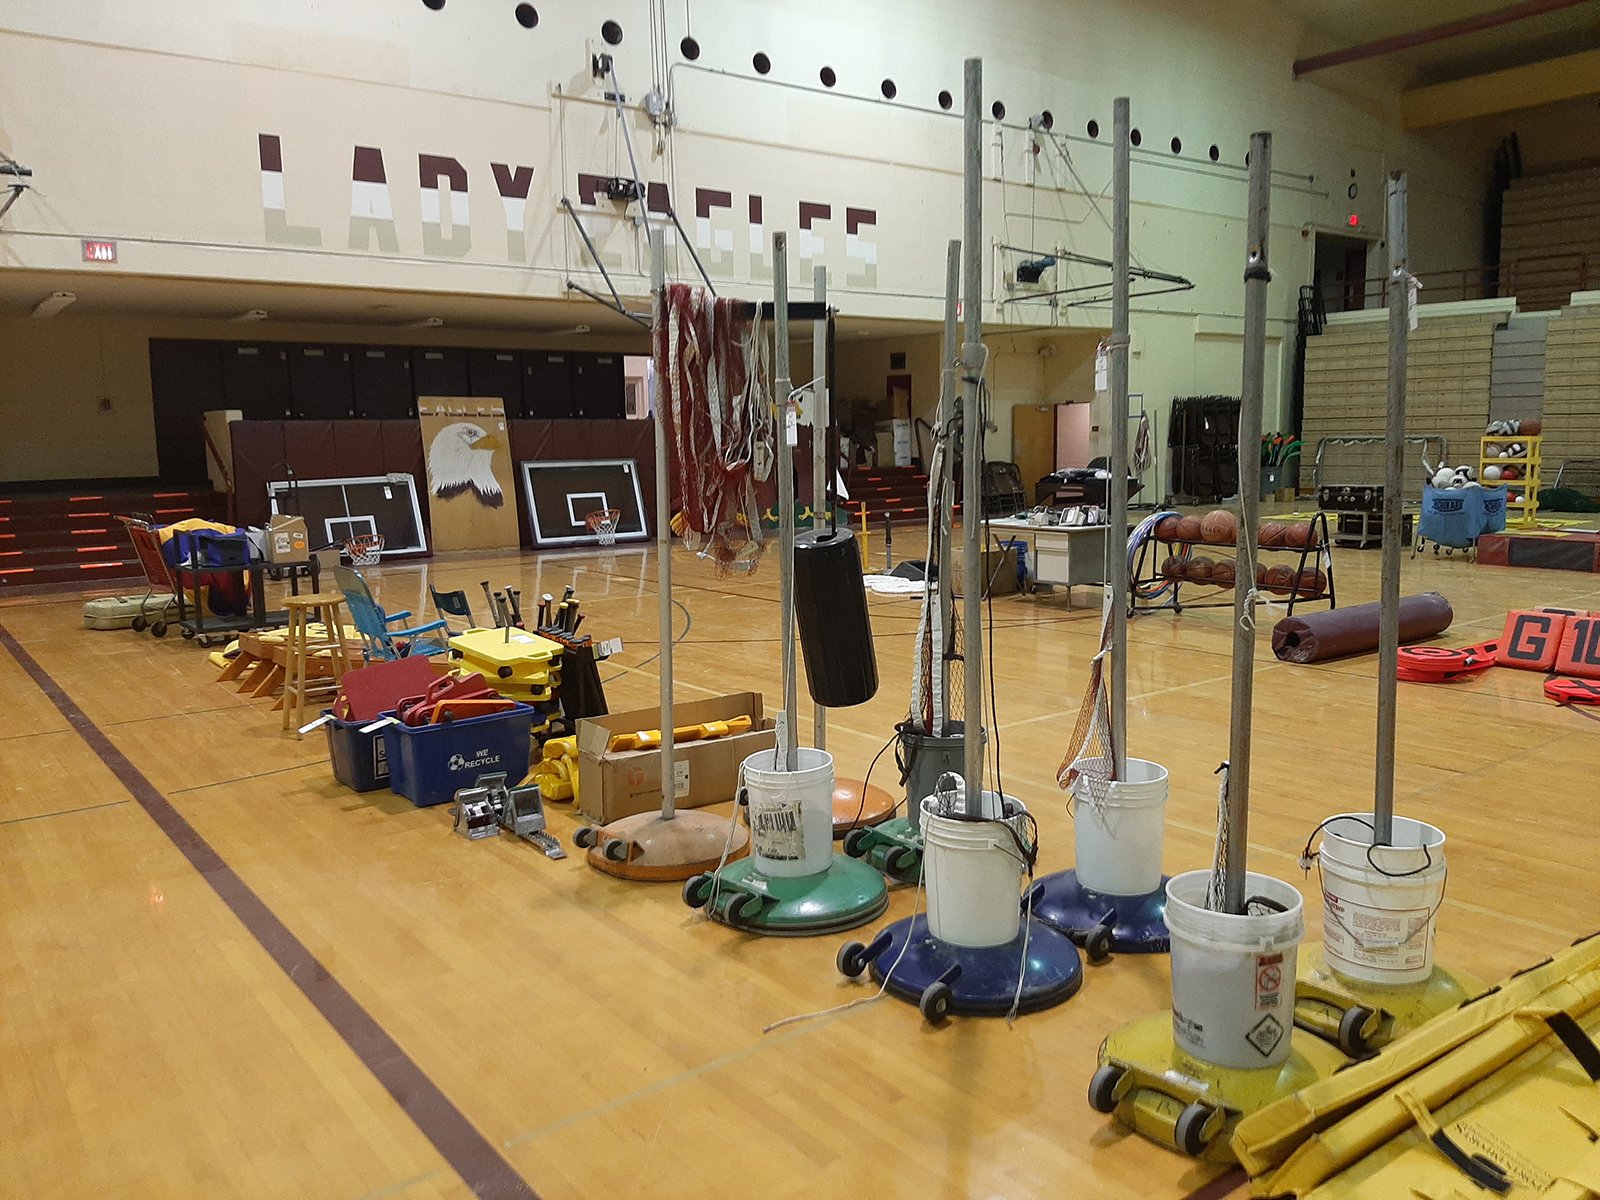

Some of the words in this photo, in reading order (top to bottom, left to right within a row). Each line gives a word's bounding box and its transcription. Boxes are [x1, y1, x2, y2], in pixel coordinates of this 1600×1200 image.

[258, 133, 533, 262] LADY
[577, 173, 877, 288] EAGLES
[1508, 614, 1552, 661] G
[464, 756, 500, 768] RECYCLE
[476, 749, 489, 757] WE
